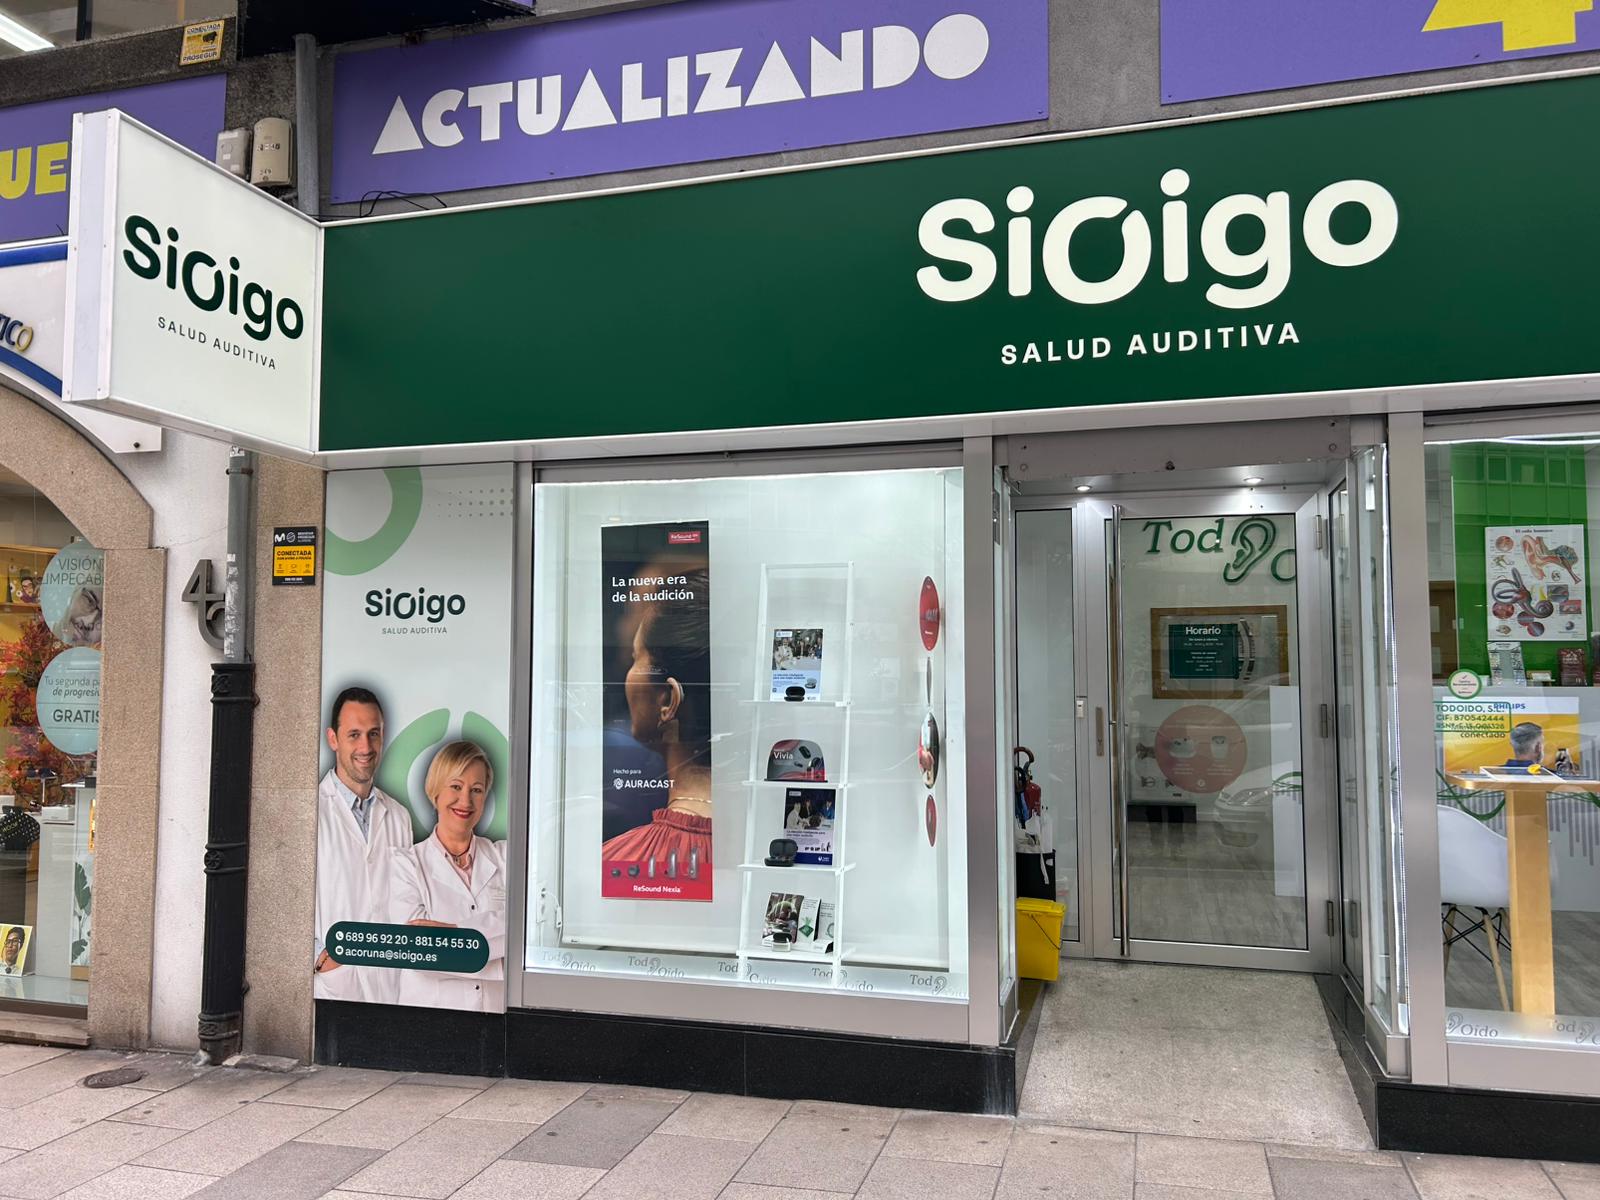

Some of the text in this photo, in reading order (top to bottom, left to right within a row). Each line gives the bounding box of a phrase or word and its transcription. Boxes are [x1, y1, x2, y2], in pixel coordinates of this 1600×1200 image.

[371, 13, 990, 156] ACTUALIZANDO
[157, 315, 276, 371] SALUD AUDITIVA
[1000, 321, 1301, 366] SALUD AUDITIVA
[612, 576, 688, 587] La nueva era
[612, 589, 694, 602] de la audición
[382, 626, 448, 635] SALUD AUDITIVA
[1185, 626, 1222, 636] Horario
[44, 676, 54, 686] Tu
[55, 676, 90, 690] segunda
[52, 686, 63, 697] de
[774, 751, 794, 760] Vivia
[624, 779, 675, 788] AURACAST
[633, 884, 681, 894] ReSound Nexia
[345, 931, 364, 943] 689
[366, 932, 379, 944] 96
[380, 934, 393, 944] 92
[394, 934, 408, 946] 20
[414, 936, 432, 947] 881
[435, 936, 448, 948] 54
[450, 938, 464, 949] 55
[466, 938, 480, 950] 30
[345, 948, 438, 963] acoruna@sioigo.es
[628, 956, 648, 968] Tod
[910, 974, 933, 986] Tod
[1554, 1020, 1576, 1032] od
